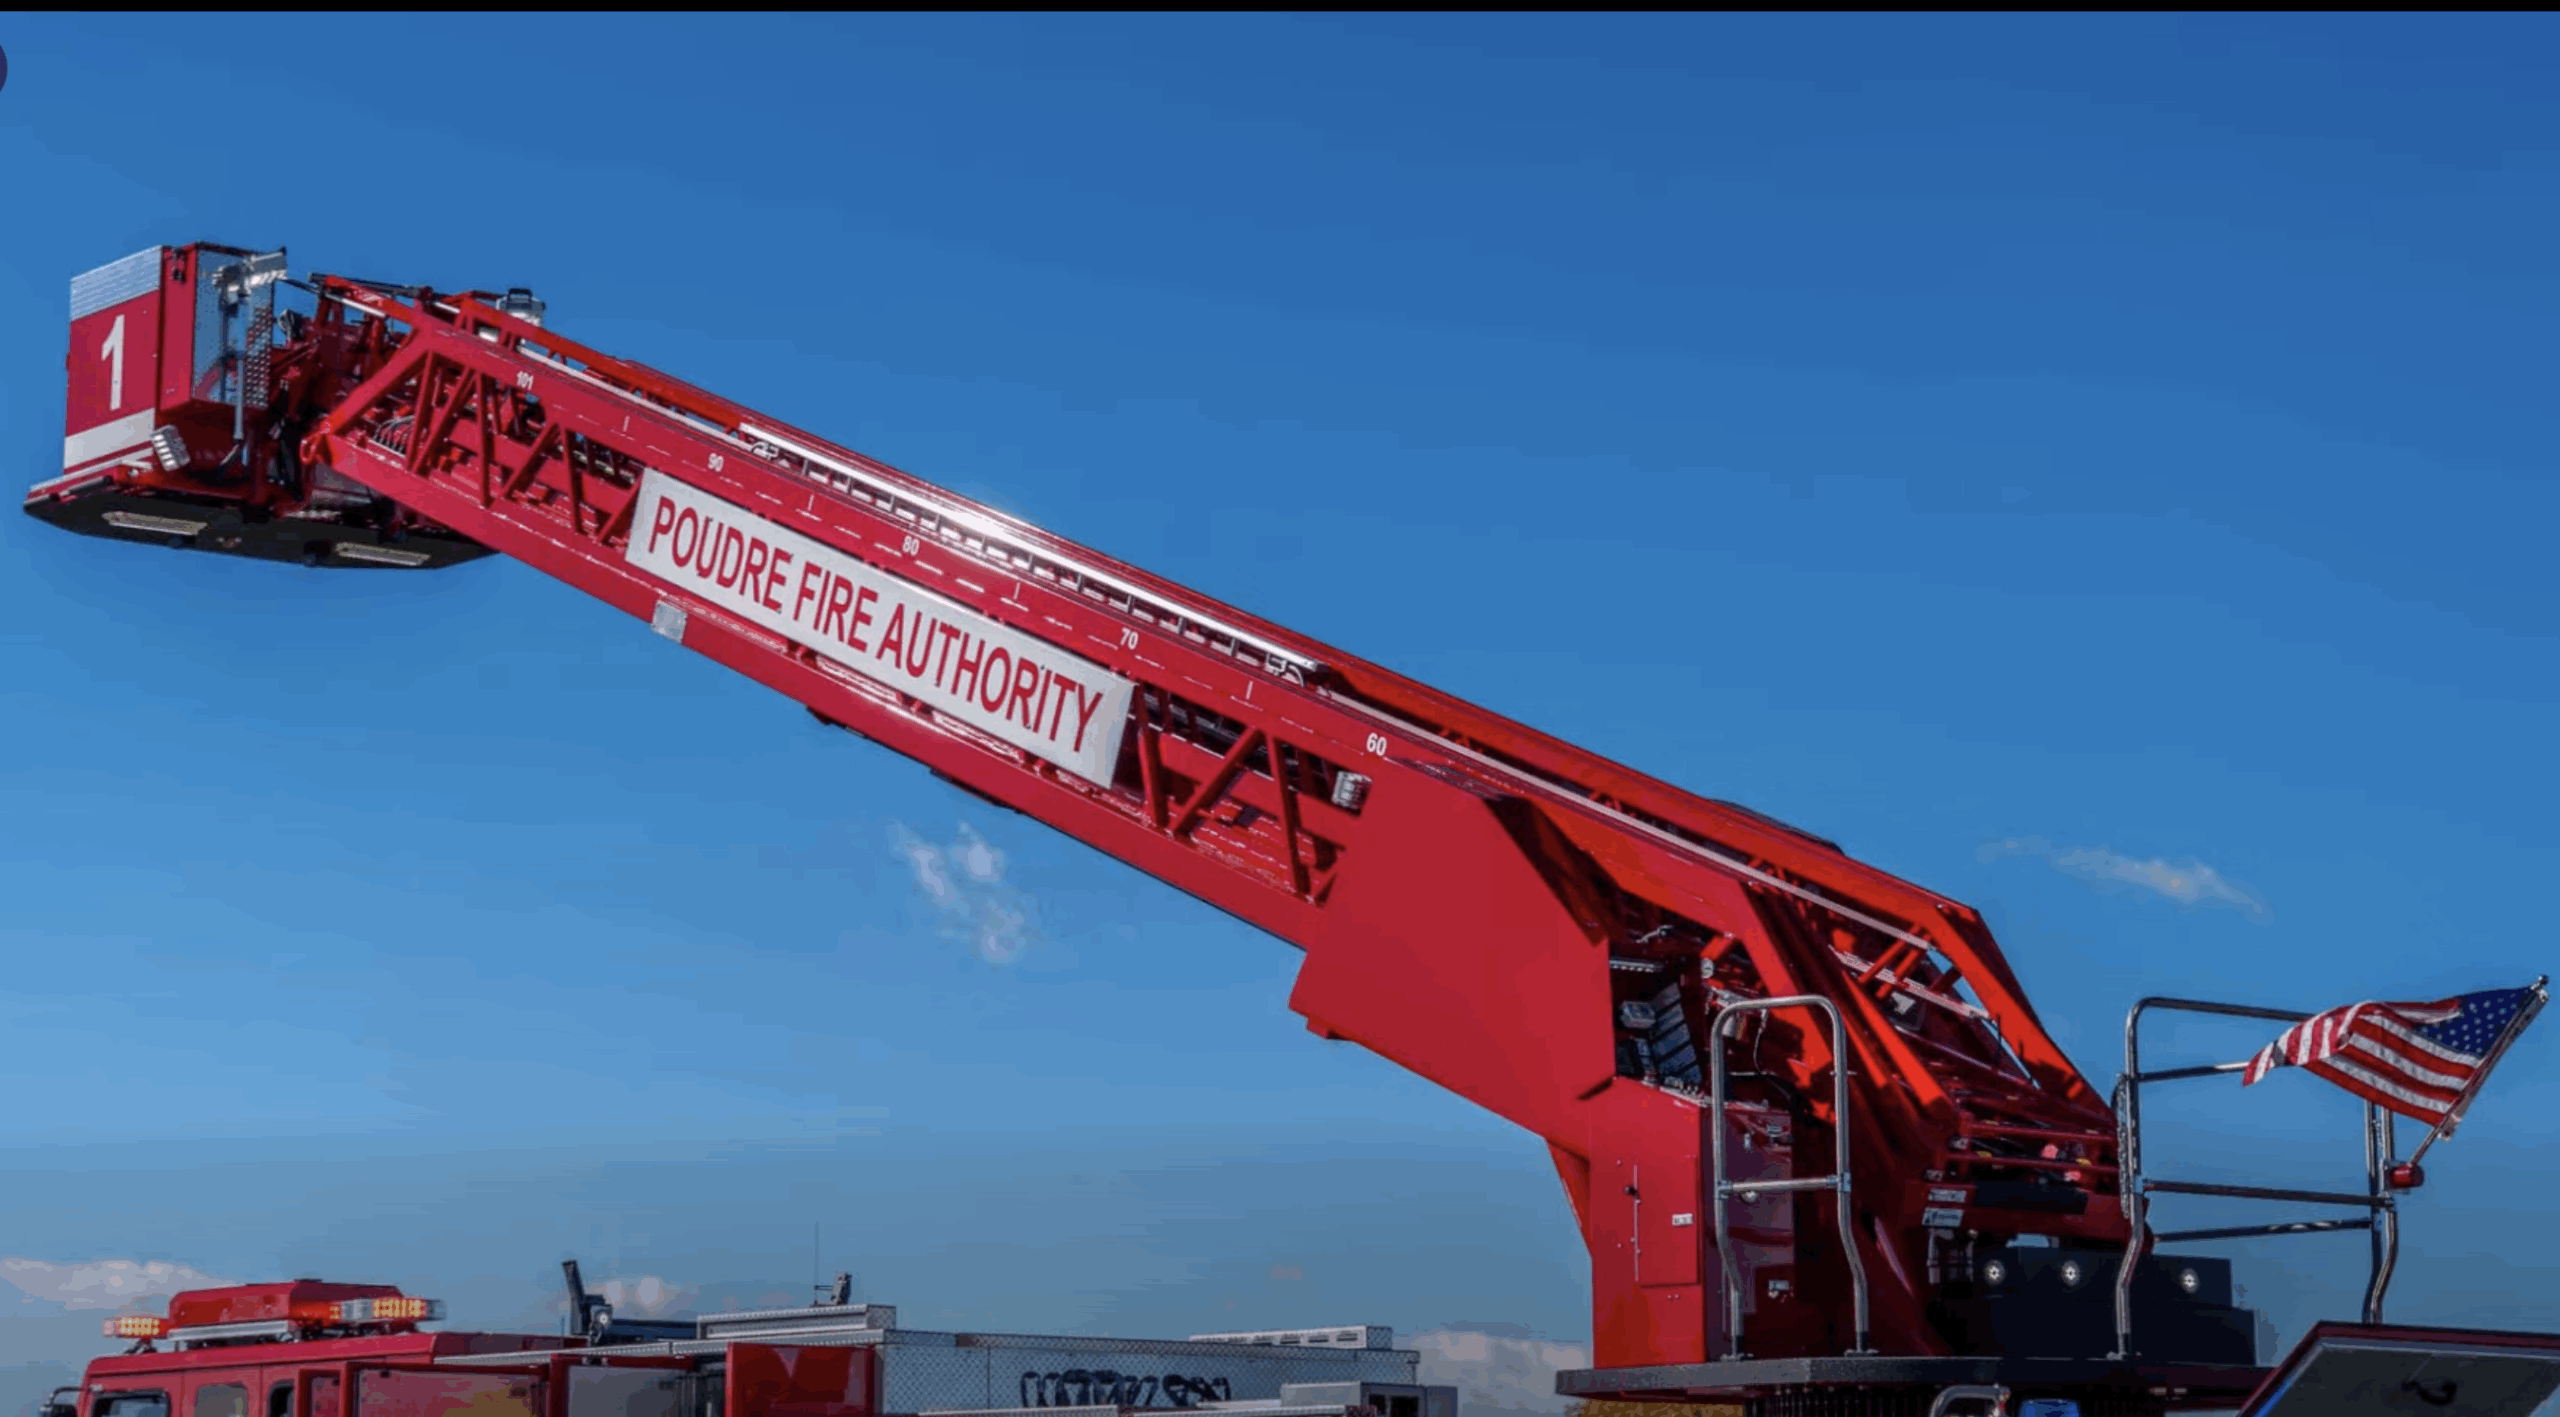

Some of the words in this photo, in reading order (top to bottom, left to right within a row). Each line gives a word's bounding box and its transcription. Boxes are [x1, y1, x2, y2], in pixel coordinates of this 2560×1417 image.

[101, 314, 125, 411] 1
[516, 370, 534, 391] 101
[708, 453, 724, 472] 90
[903, 535, 919, 556] 80
[647, 495, 792, 614] POUDRE
[792, 561, 879, 654] FIRE
[875, 603, 1104, 753] AUTHORITY
[1120, 627, 1138, 650] 70
[1367, 732, 1387, 756] 60
